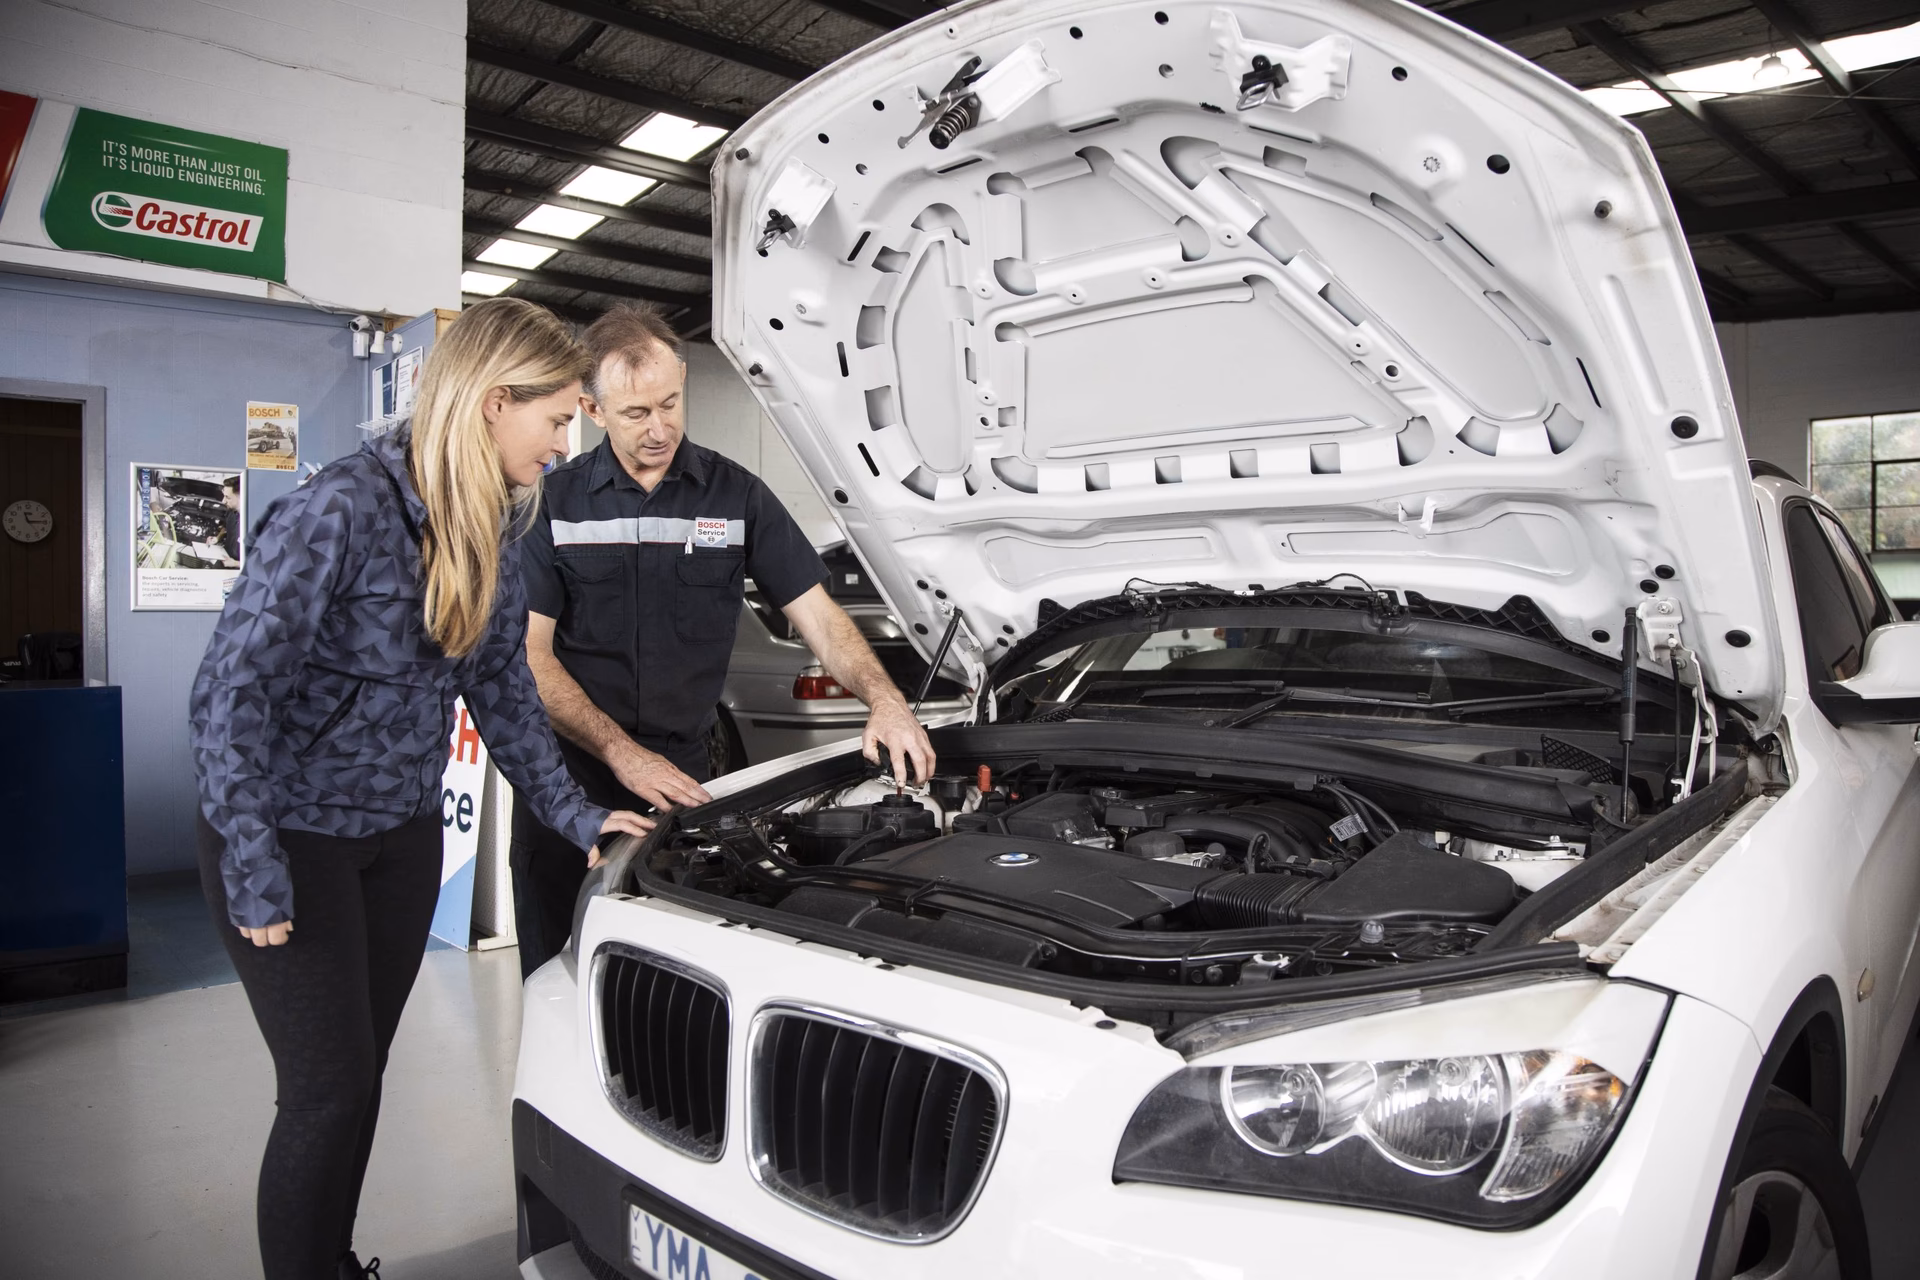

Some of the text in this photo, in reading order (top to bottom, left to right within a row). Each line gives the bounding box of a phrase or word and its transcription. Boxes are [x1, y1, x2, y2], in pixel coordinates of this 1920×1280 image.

[103, 140, 266, 182] IT'S MORE THAN JUST OIL.
[103, 155, 266, 196] IT'S LIQUID ENGINEERING.
[136, 202, 251, 246] Castrol
[248, 408, 281, 417] BOSCH
[697, 521, 725, 529] BOSCH
[697, 528, 726, 536] Service
[644, 1213, 711, 1280] YMA
